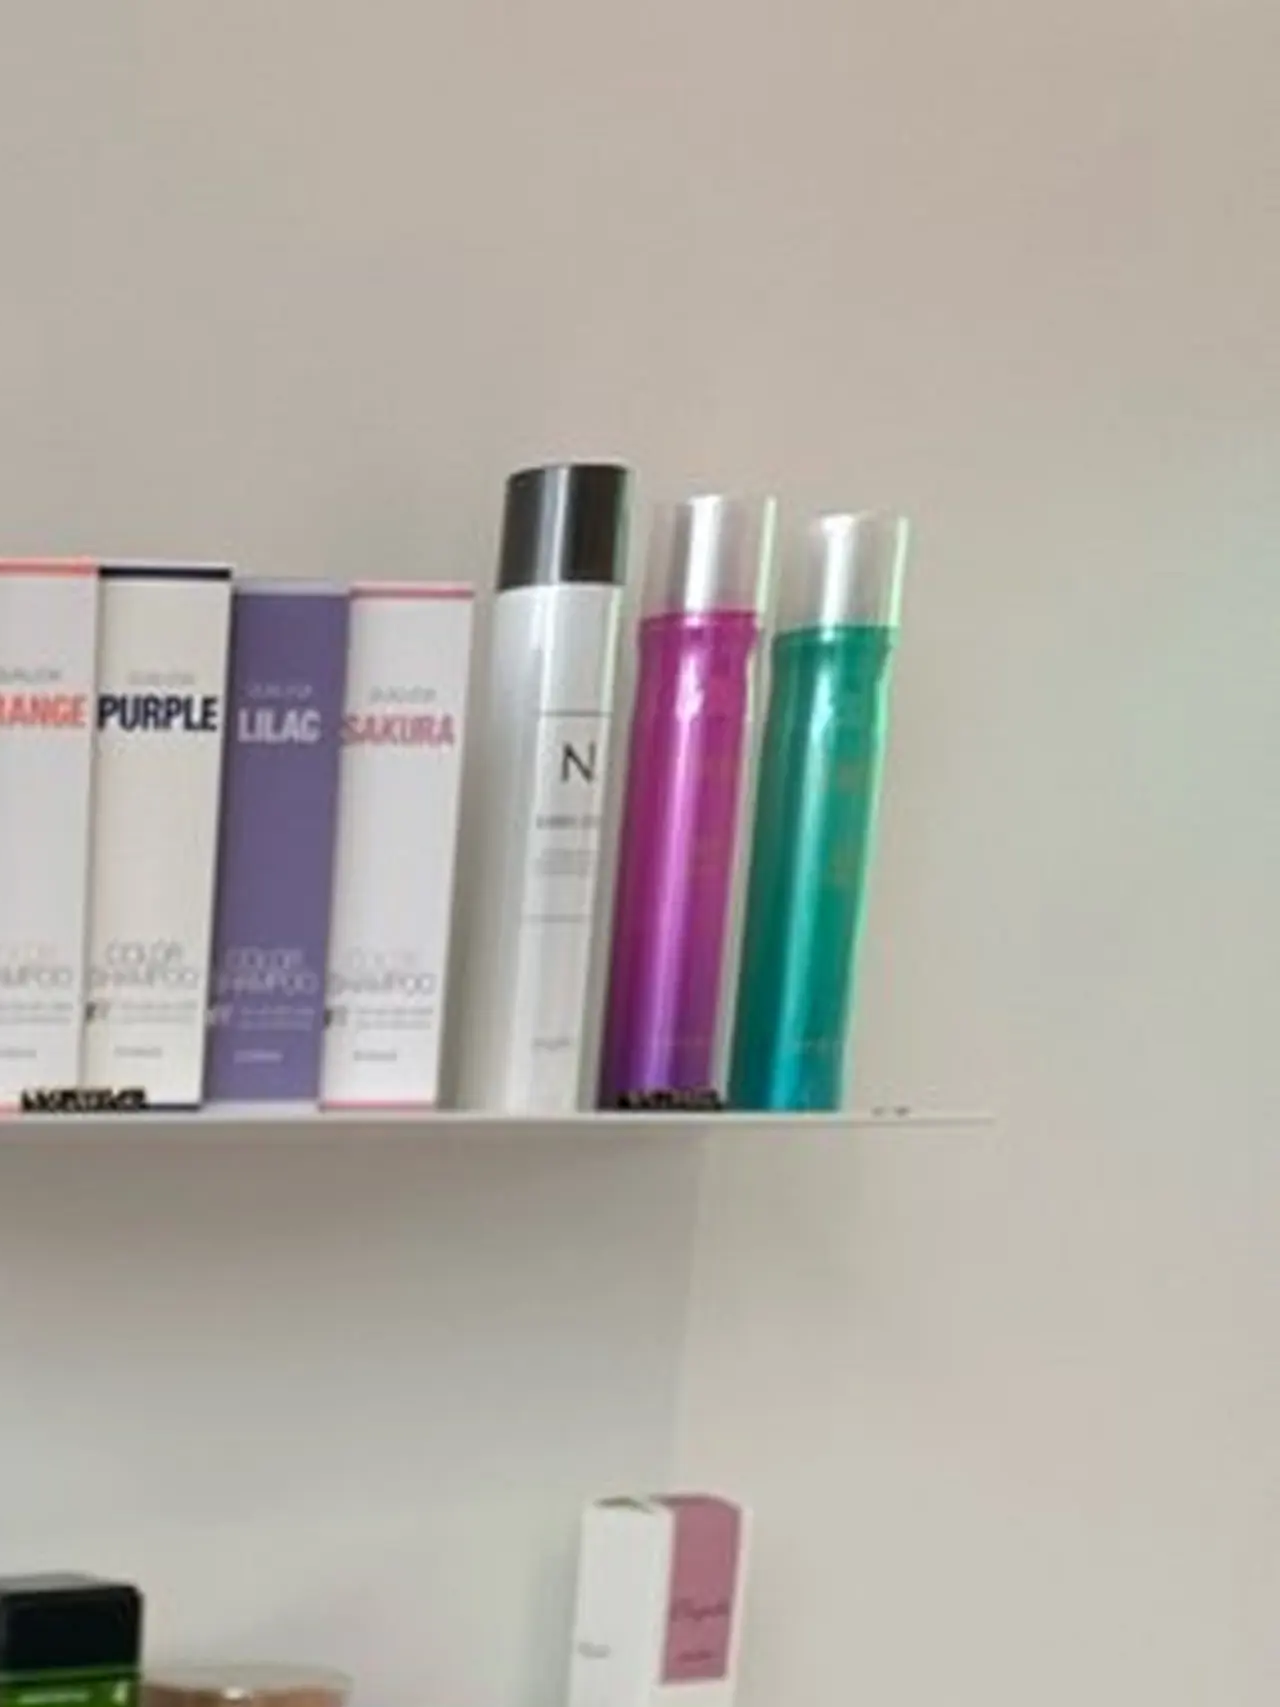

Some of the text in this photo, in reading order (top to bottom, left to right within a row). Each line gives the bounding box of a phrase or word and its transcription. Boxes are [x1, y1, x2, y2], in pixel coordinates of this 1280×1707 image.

[97, 694, 217, 732] PURPLE
[238, 707, 321, 745] LILAC
[341, 713, 454, 746] SAKURA
[561, 742, 596, 783] N
